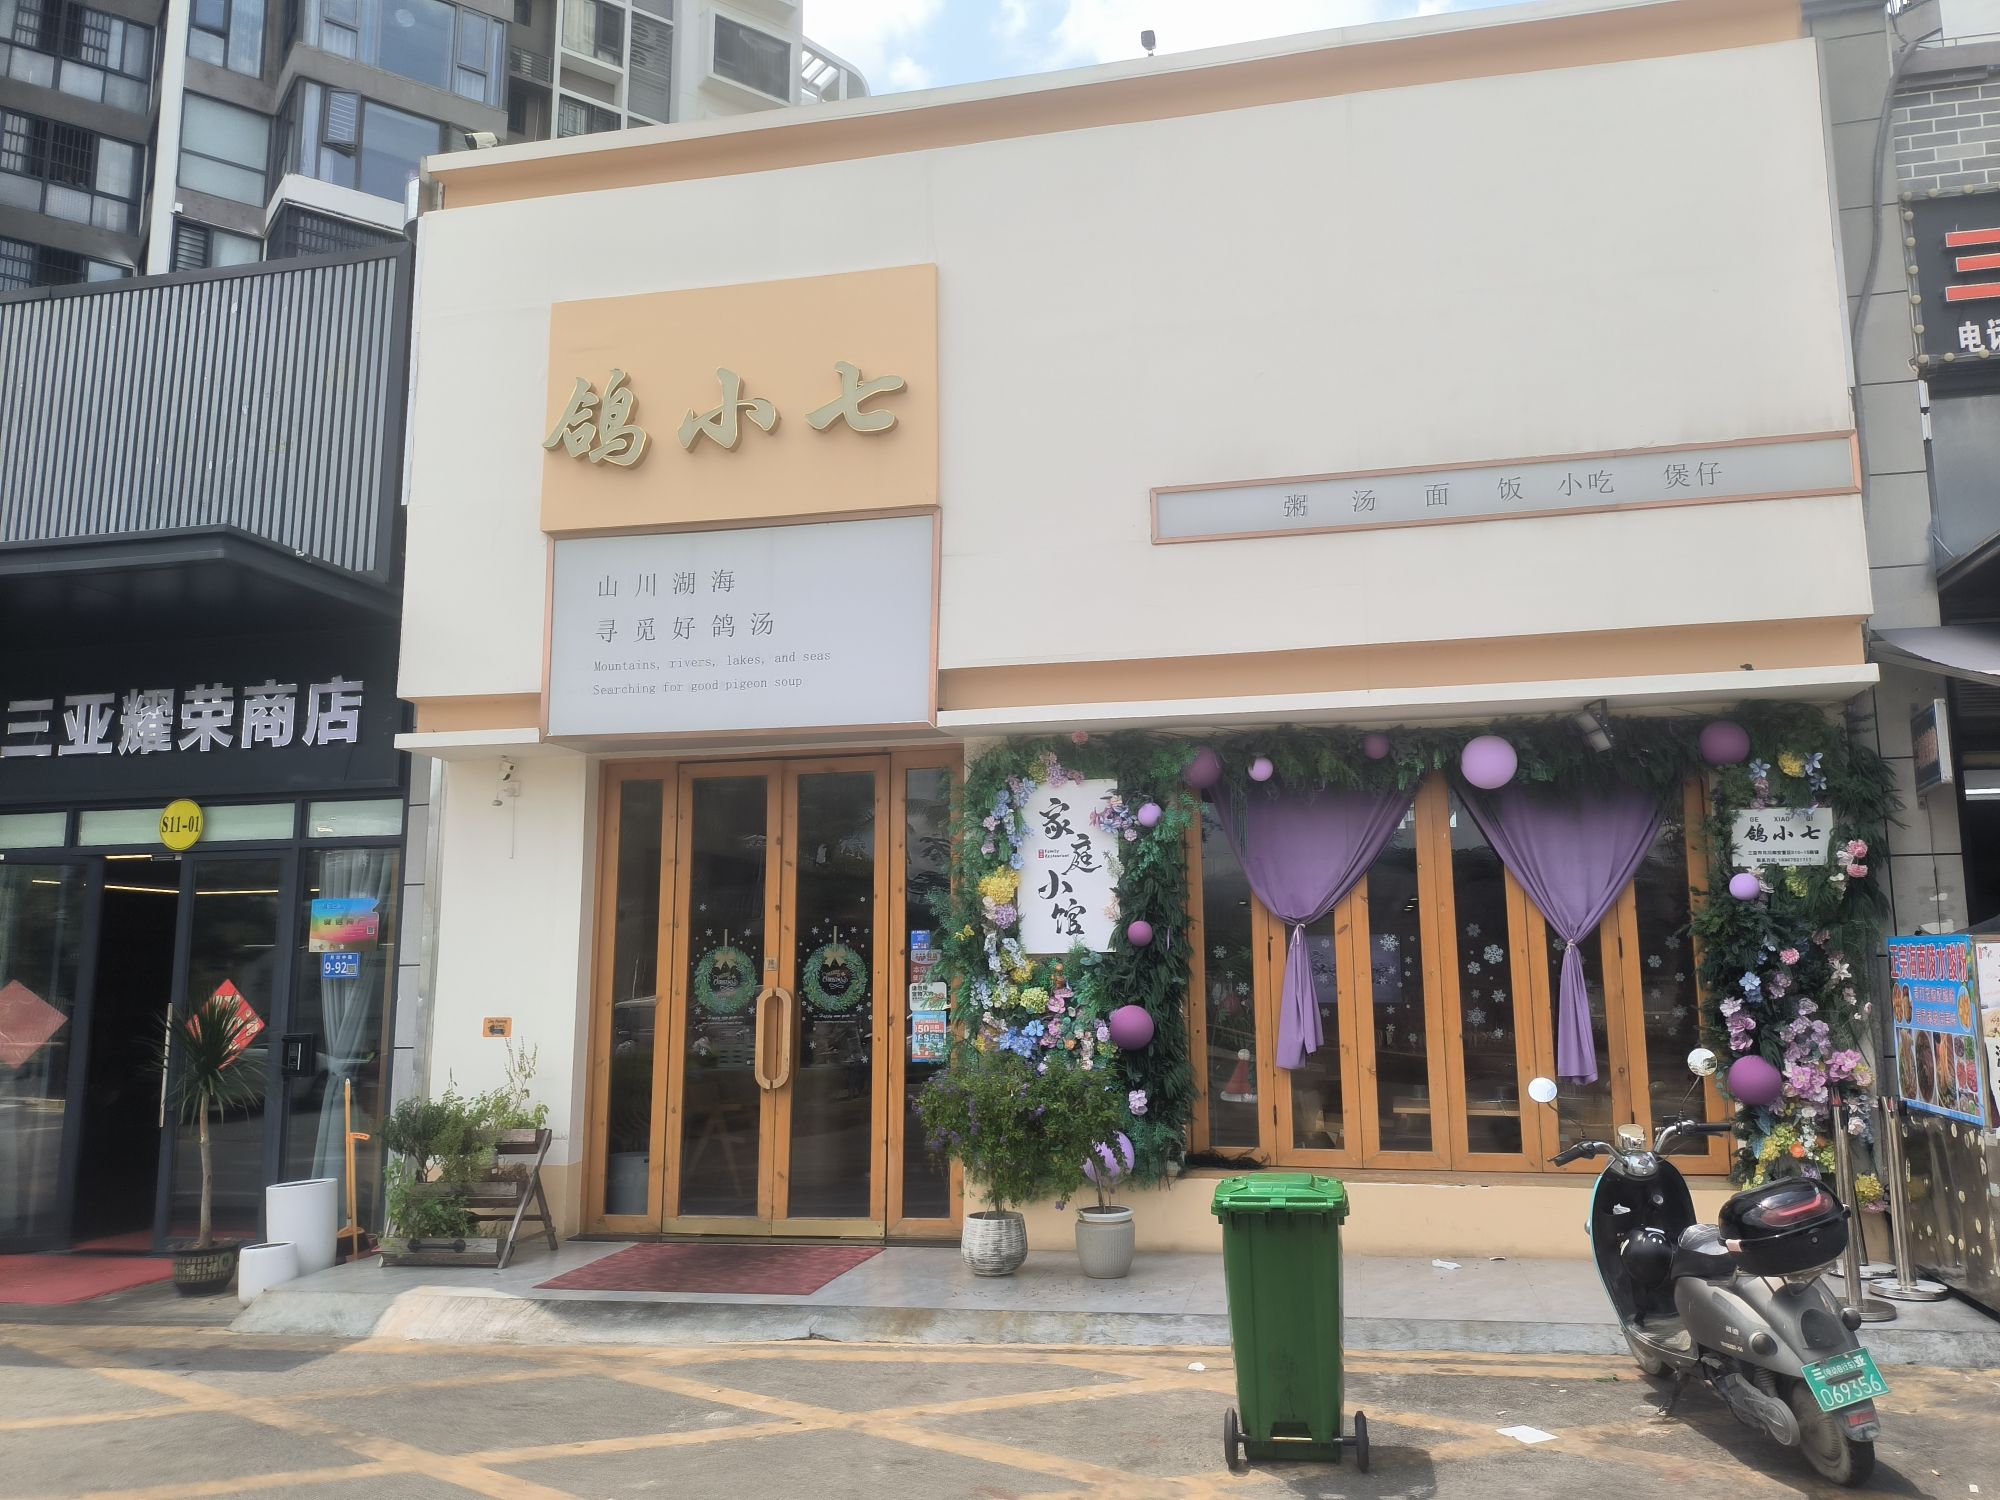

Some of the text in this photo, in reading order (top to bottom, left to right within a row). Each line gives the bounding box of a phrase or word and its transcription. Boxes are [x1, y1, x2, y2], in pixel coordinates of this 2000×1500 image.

[543, 360, 908, 468] 鸽小七
[1283, 461, 1722, 518] 粥 汤 面 饭 小吃 煲仔
[596, 569, 736, 600] 山川湖海
[595, 611, 775, 645] 寻觅好鸽汤
[593, 651, 832, 673] Mountains, rivers, lakes, and seas
[593, 677, 803, 696] Searching for good pigeon soup
[0, 675, 364, 758] 三亚耀荣商店
[161, 815, 200, 834] S11-01
[1744, 823, 1821, 843] 鸽小七
[1038, 797, 1103, 936] 家庭小馆
[325, 961, 347, 975] 9-92
[1820, 1374, 1882, 1407] 069356
